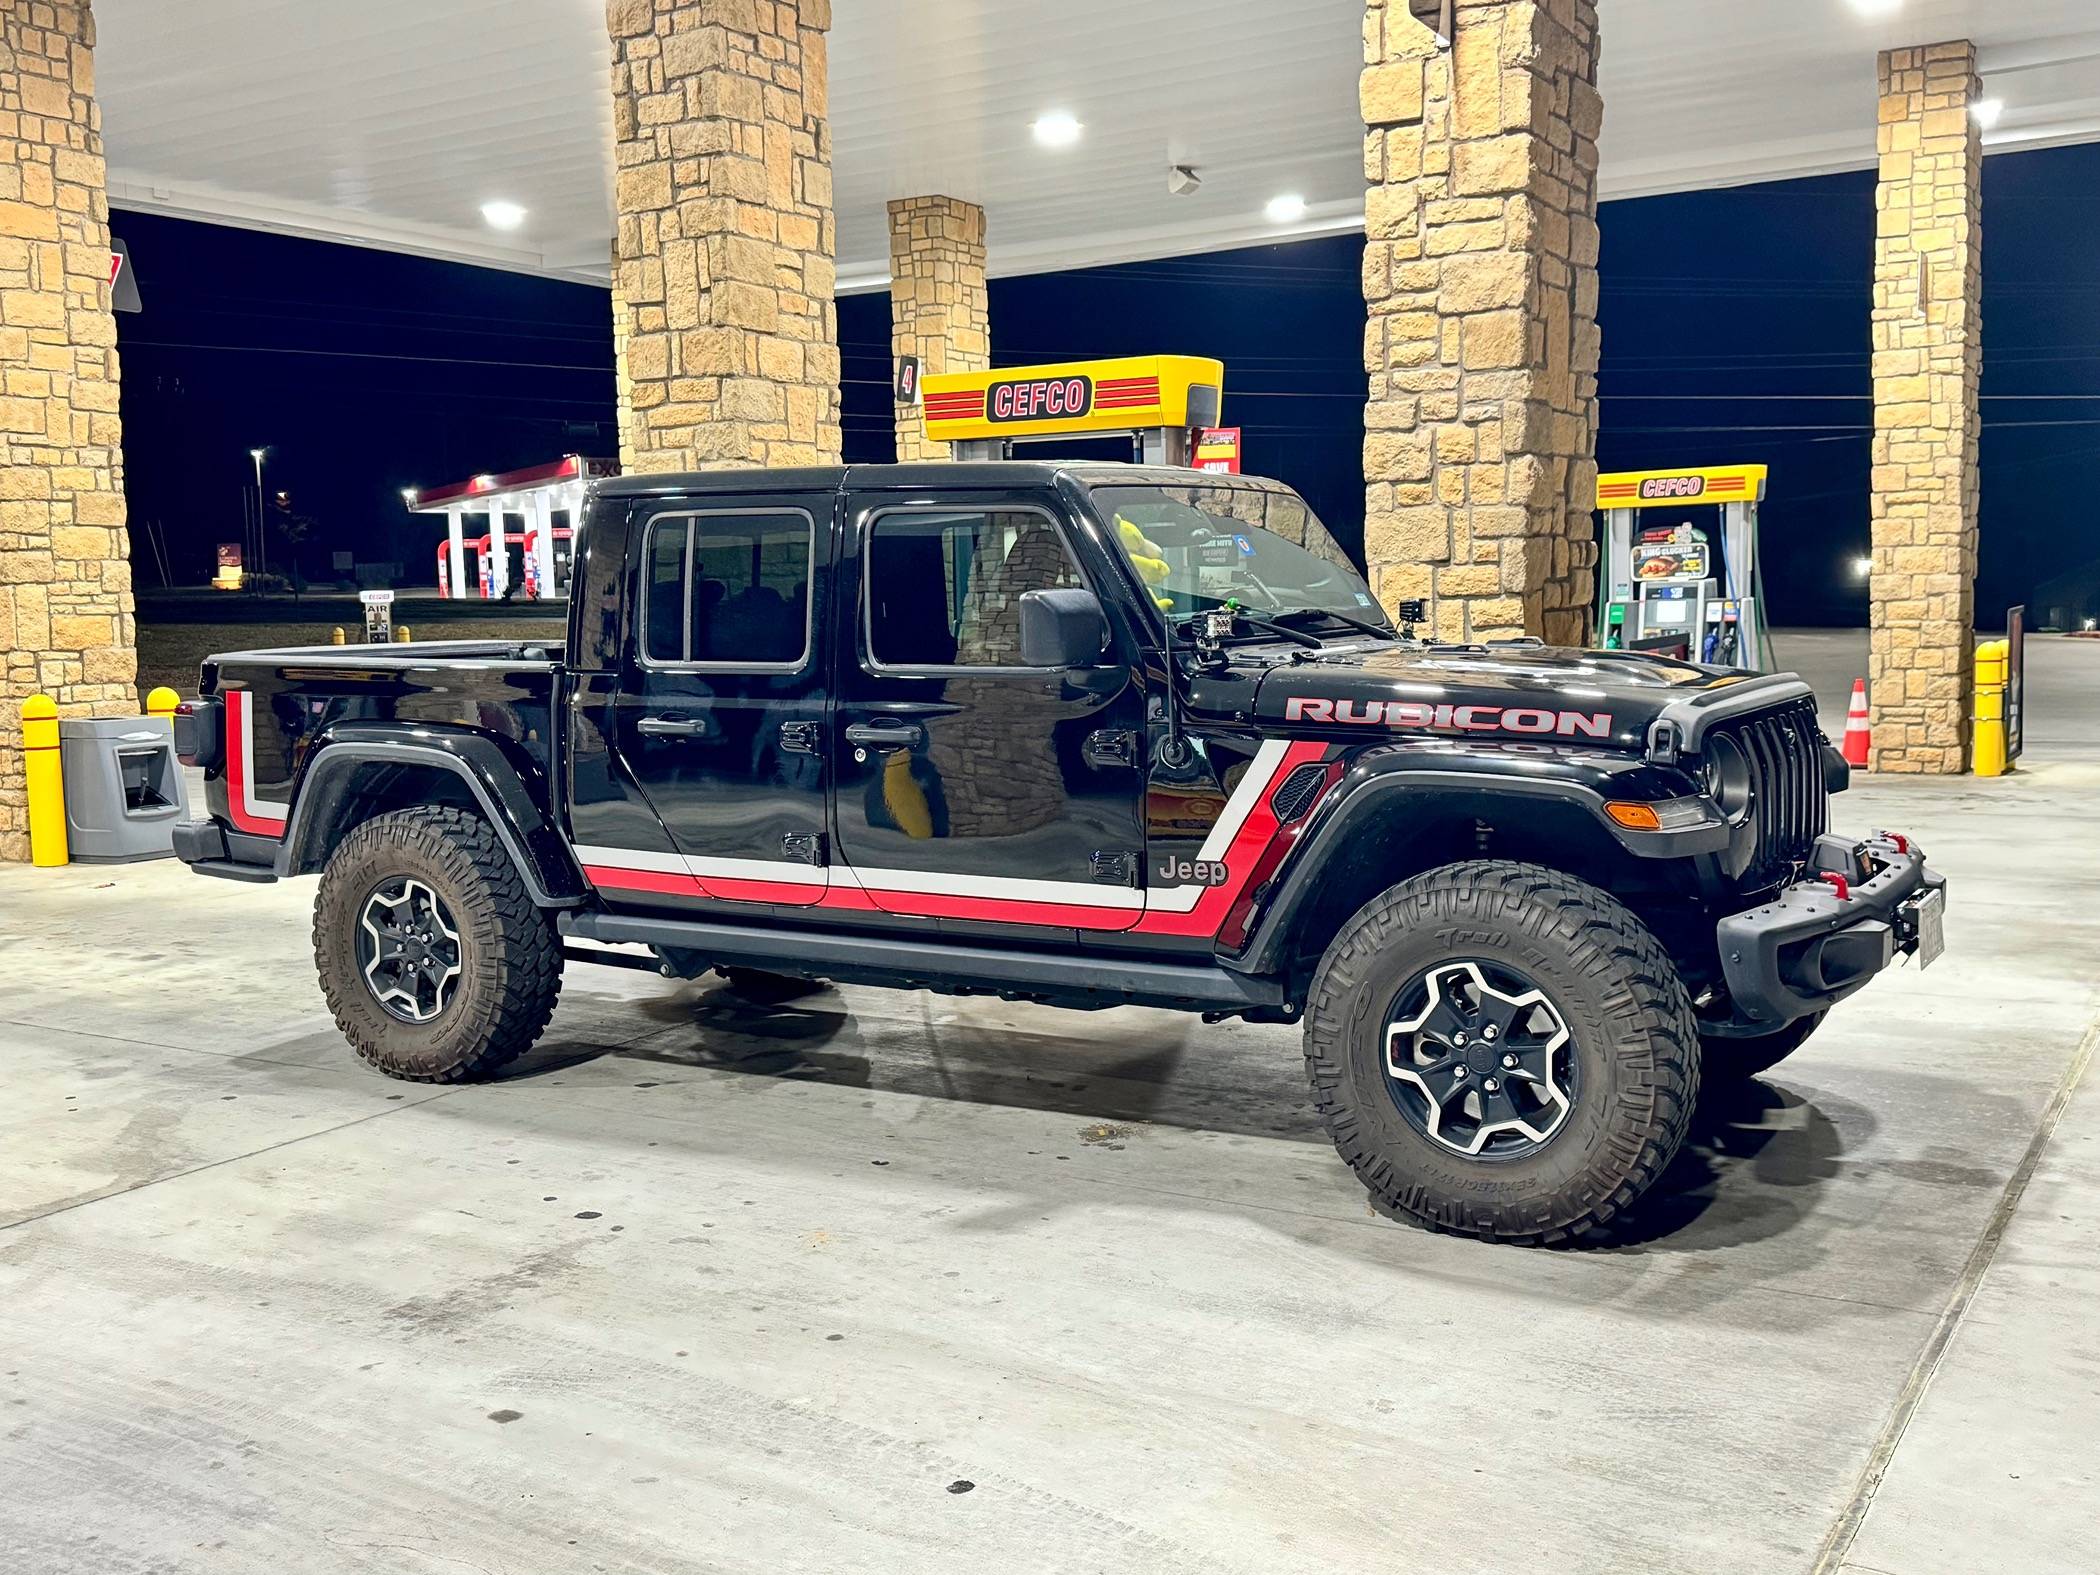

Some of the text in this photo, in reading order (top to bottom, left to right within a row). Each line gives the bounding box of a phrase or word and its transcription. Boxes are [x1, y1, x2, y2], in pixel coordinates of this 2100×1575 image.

[901, 364, 914, 394] 4
[994, 378, 1085, 418] CEFCO
[1643, 477, 1701, 497] CEFCO
[367, 605, 388, 613] AIR
[1285, 697, 1613, 738] RUBICON
[1159, 855, 1227, 885] Jeep
